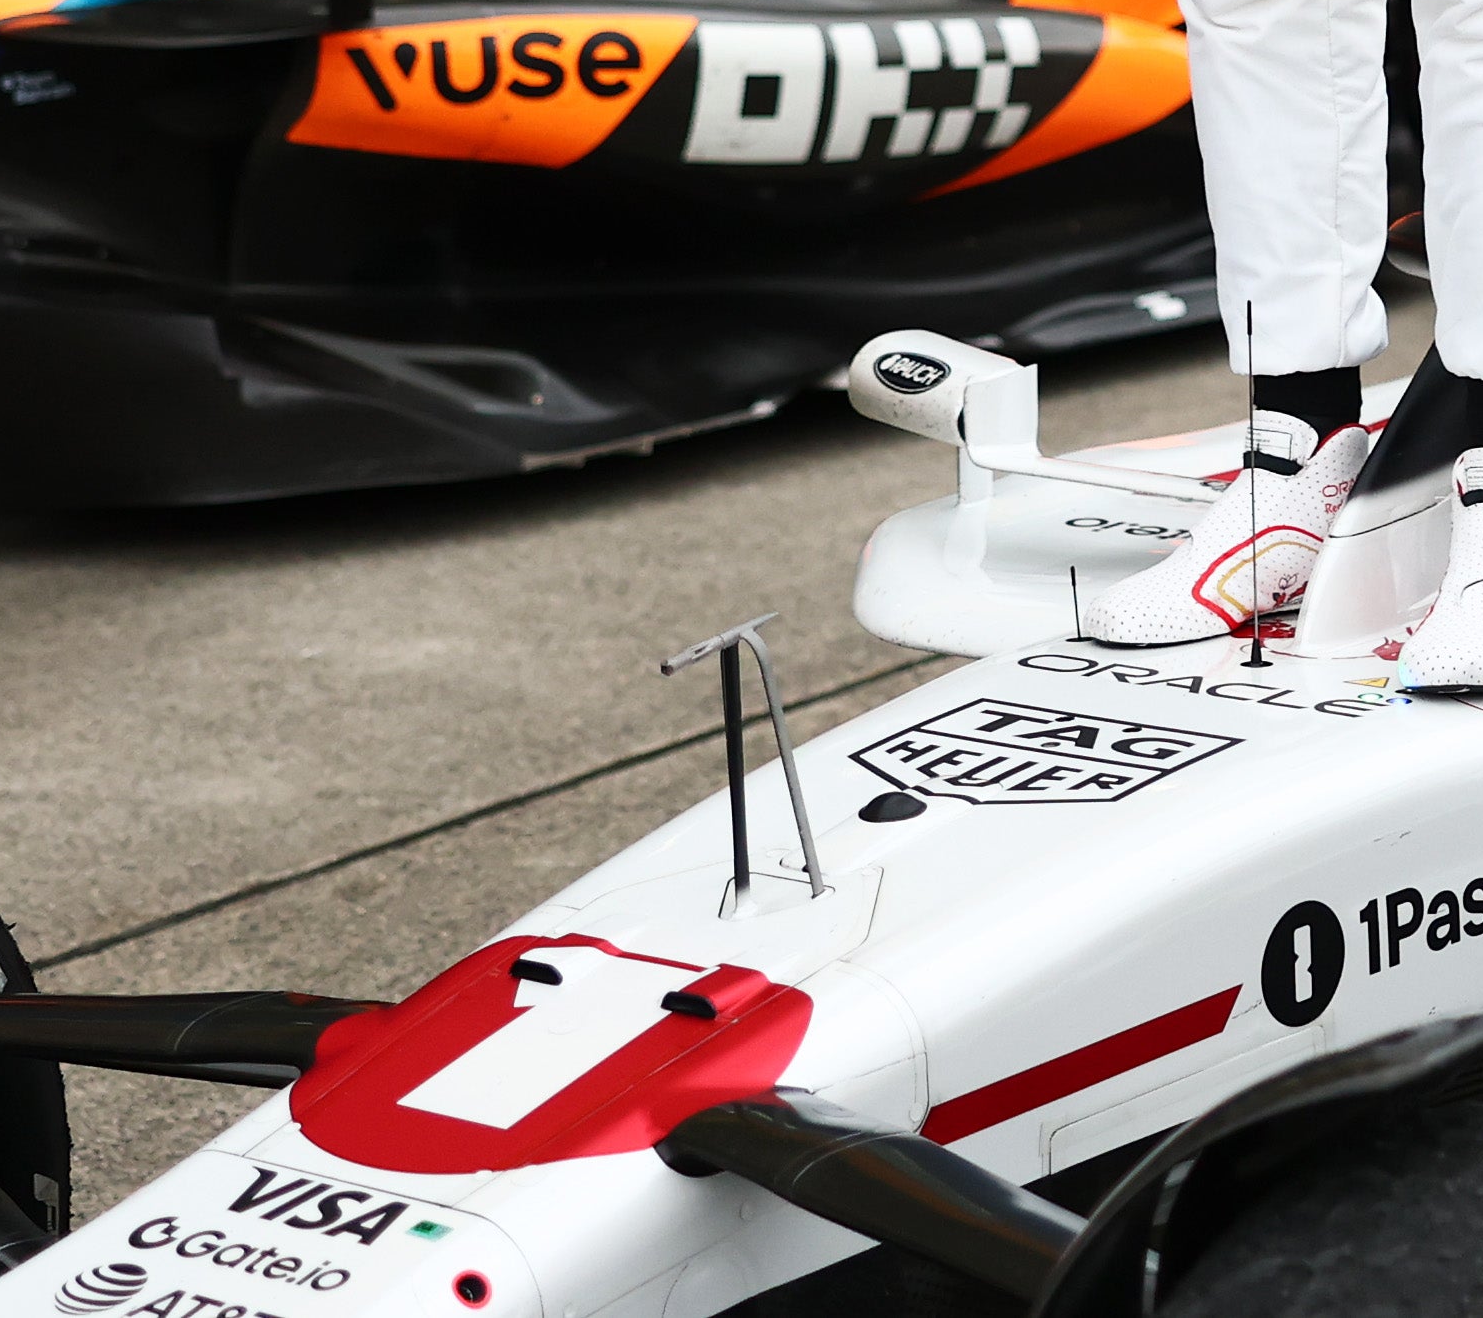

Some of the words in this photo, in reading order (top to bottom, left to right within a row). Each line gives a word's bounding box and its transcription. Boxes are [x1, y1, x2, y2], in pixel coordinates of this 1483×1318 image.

[683, 15, 1042, 164] OKX
[895, 353, 944, 387] RAUCH
[1017, 652, 1388, 721] ORACLE
[875, 739, 1142, 795] HEUER
[969, 706, 1197, 763] TAG
[396, 945, 722, 1131] 1
[227, 1165, 413, 1247] VISA
[174, 1227, 353, 1293] Gate.io
